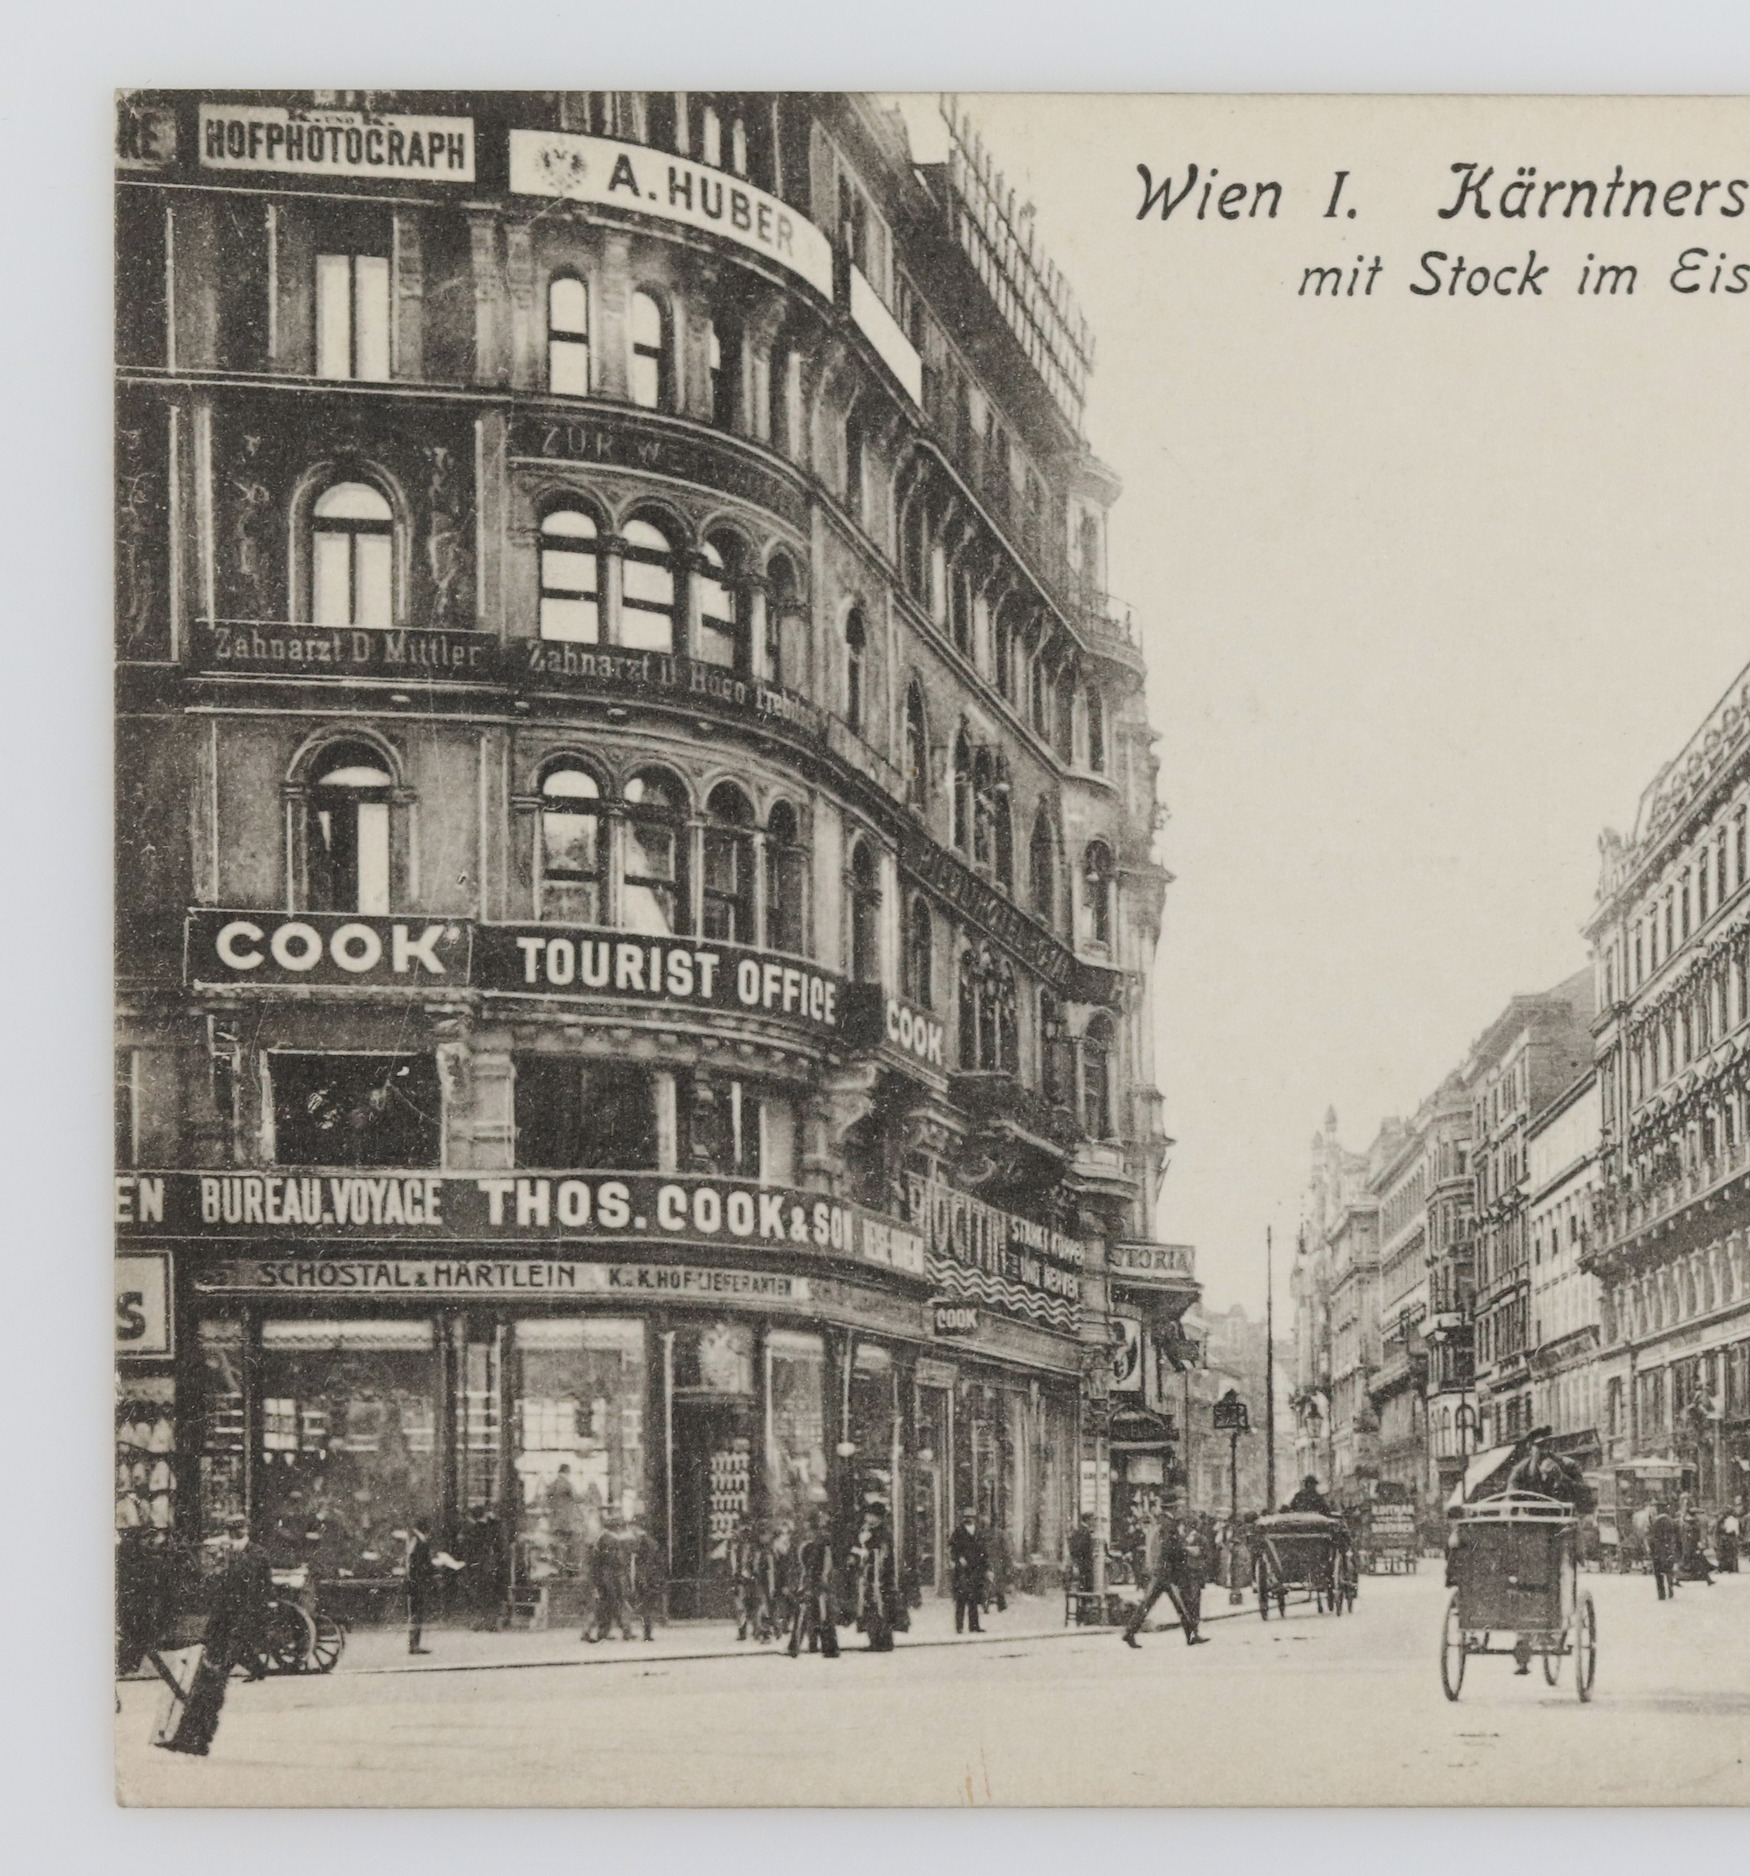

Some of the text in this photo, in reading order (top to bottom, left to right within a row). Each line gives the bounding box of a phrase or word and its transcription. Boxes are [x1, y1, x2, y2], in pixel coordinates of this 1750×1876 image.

[206, 119, 466, 170] HOFPHOTOGRAPH
[667, 164, 796, 260] HUBER
[214, 626, 342, 662] Zahnarzt
[384, 631, 483, 667] Mittler
[526, 639, 652, 682] Zahnarzt
[214, 920, 448, 975] COOK
[516, 936, 945, 1067] TOURIST OFFICE COOK
[477, 1179, 649, 1231] THOS.
[656, 1183, 787, 1240] COOK
[789, 1205, 810, 1245] &
[812, 1201, 854, 1254] SON
[936, 1307, 978, 1330] COOK
